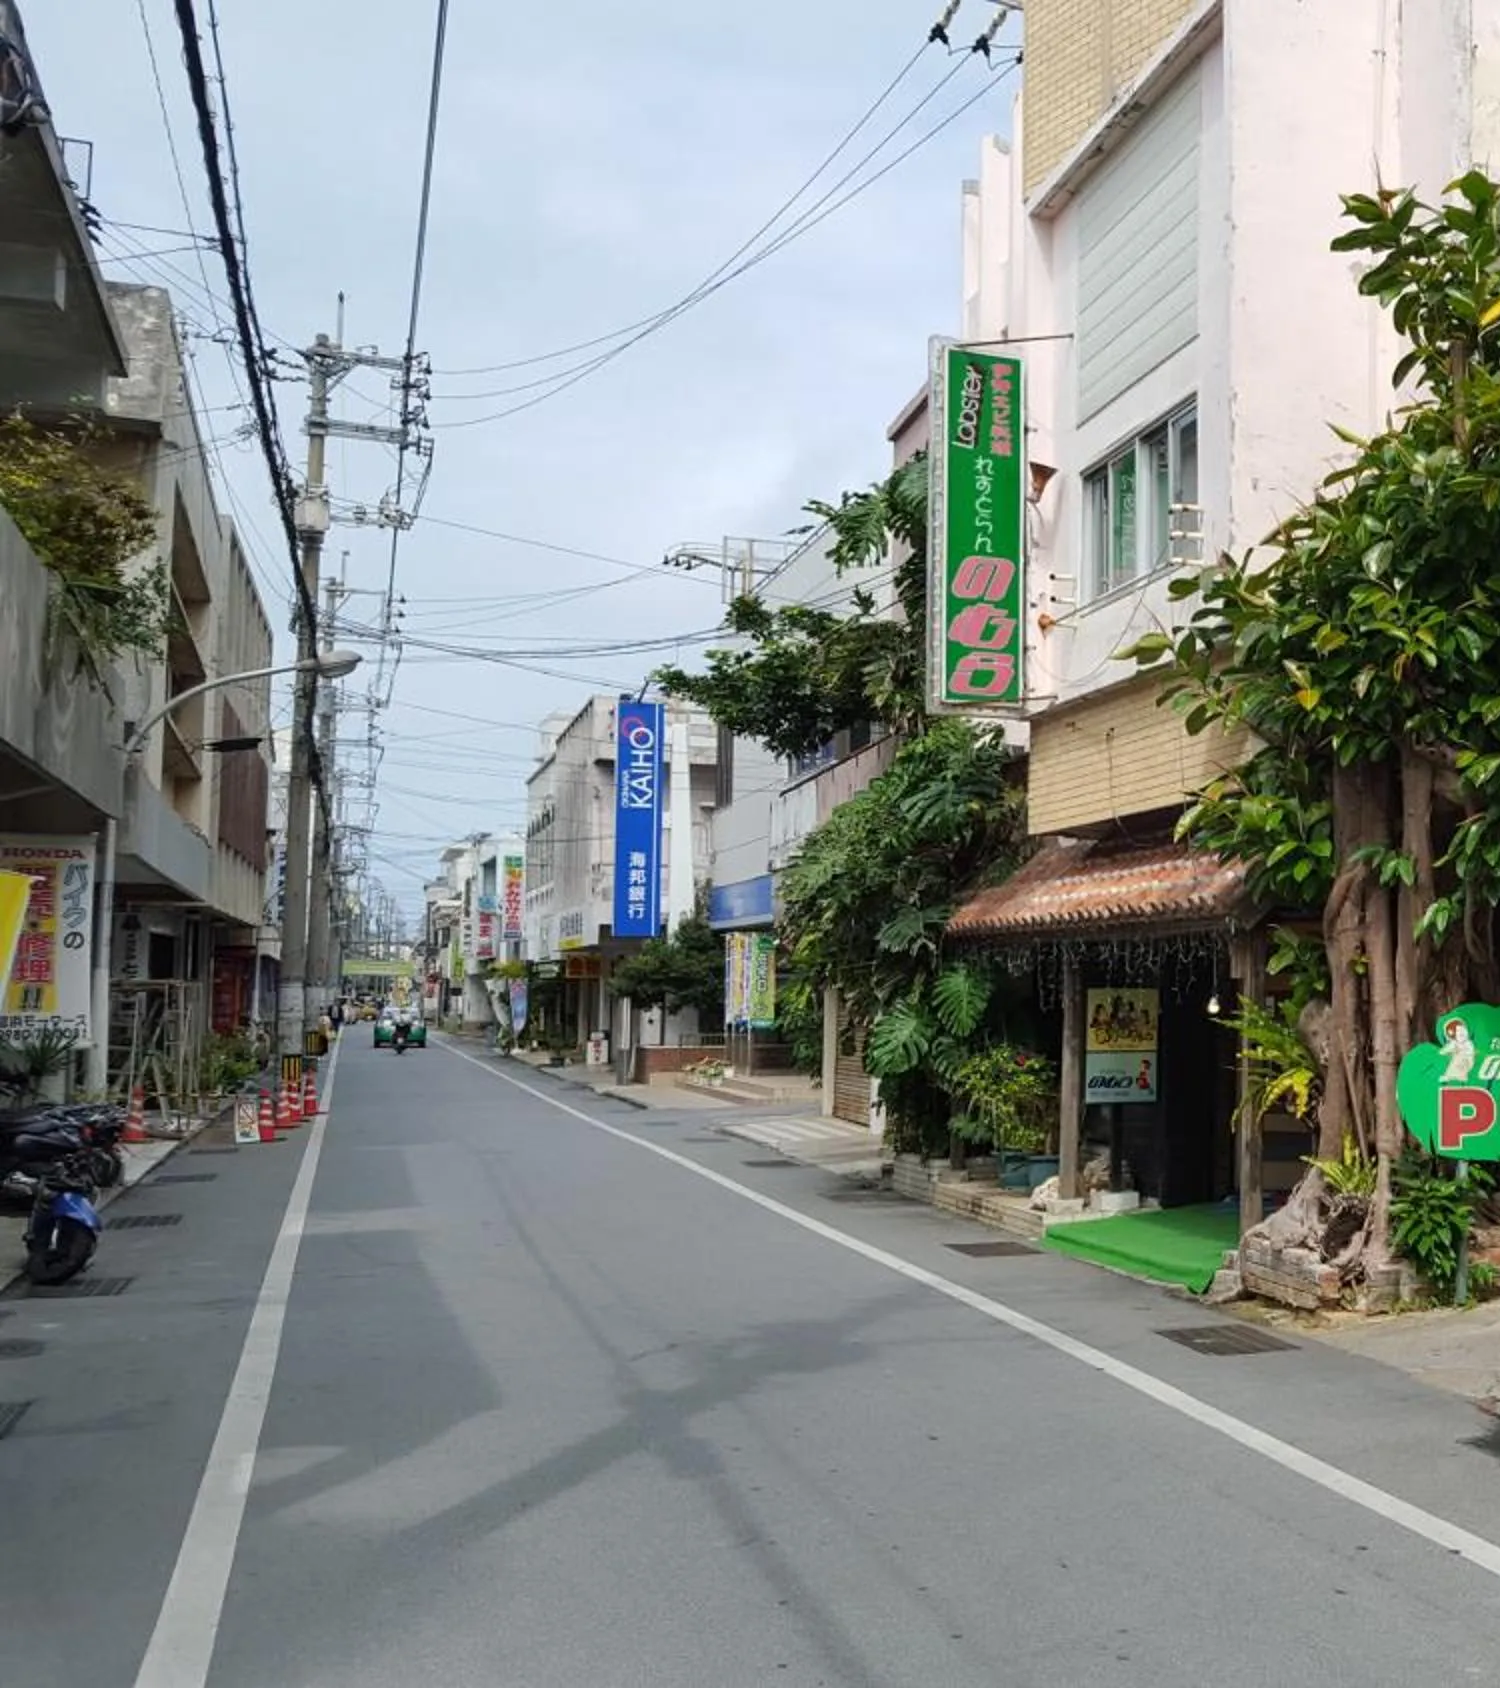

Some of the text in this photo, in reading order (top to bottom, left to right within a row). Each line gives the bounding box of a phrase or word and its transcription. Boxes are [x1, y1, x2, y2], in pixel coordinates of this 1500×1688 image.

[951, 365, 983, 449] Lobster
[974, 455, 993, 553] れすとらん
[948, 555, 1017, 696] のむら
[629, 727, 654, 808] KAIHO
[3, 847, 86, 859] HONDA
[628, 851, 647, 920] 海邦銀行
[62, 863, 88, 950] バイクの
[1438, 1085, 1497, 1151] P
